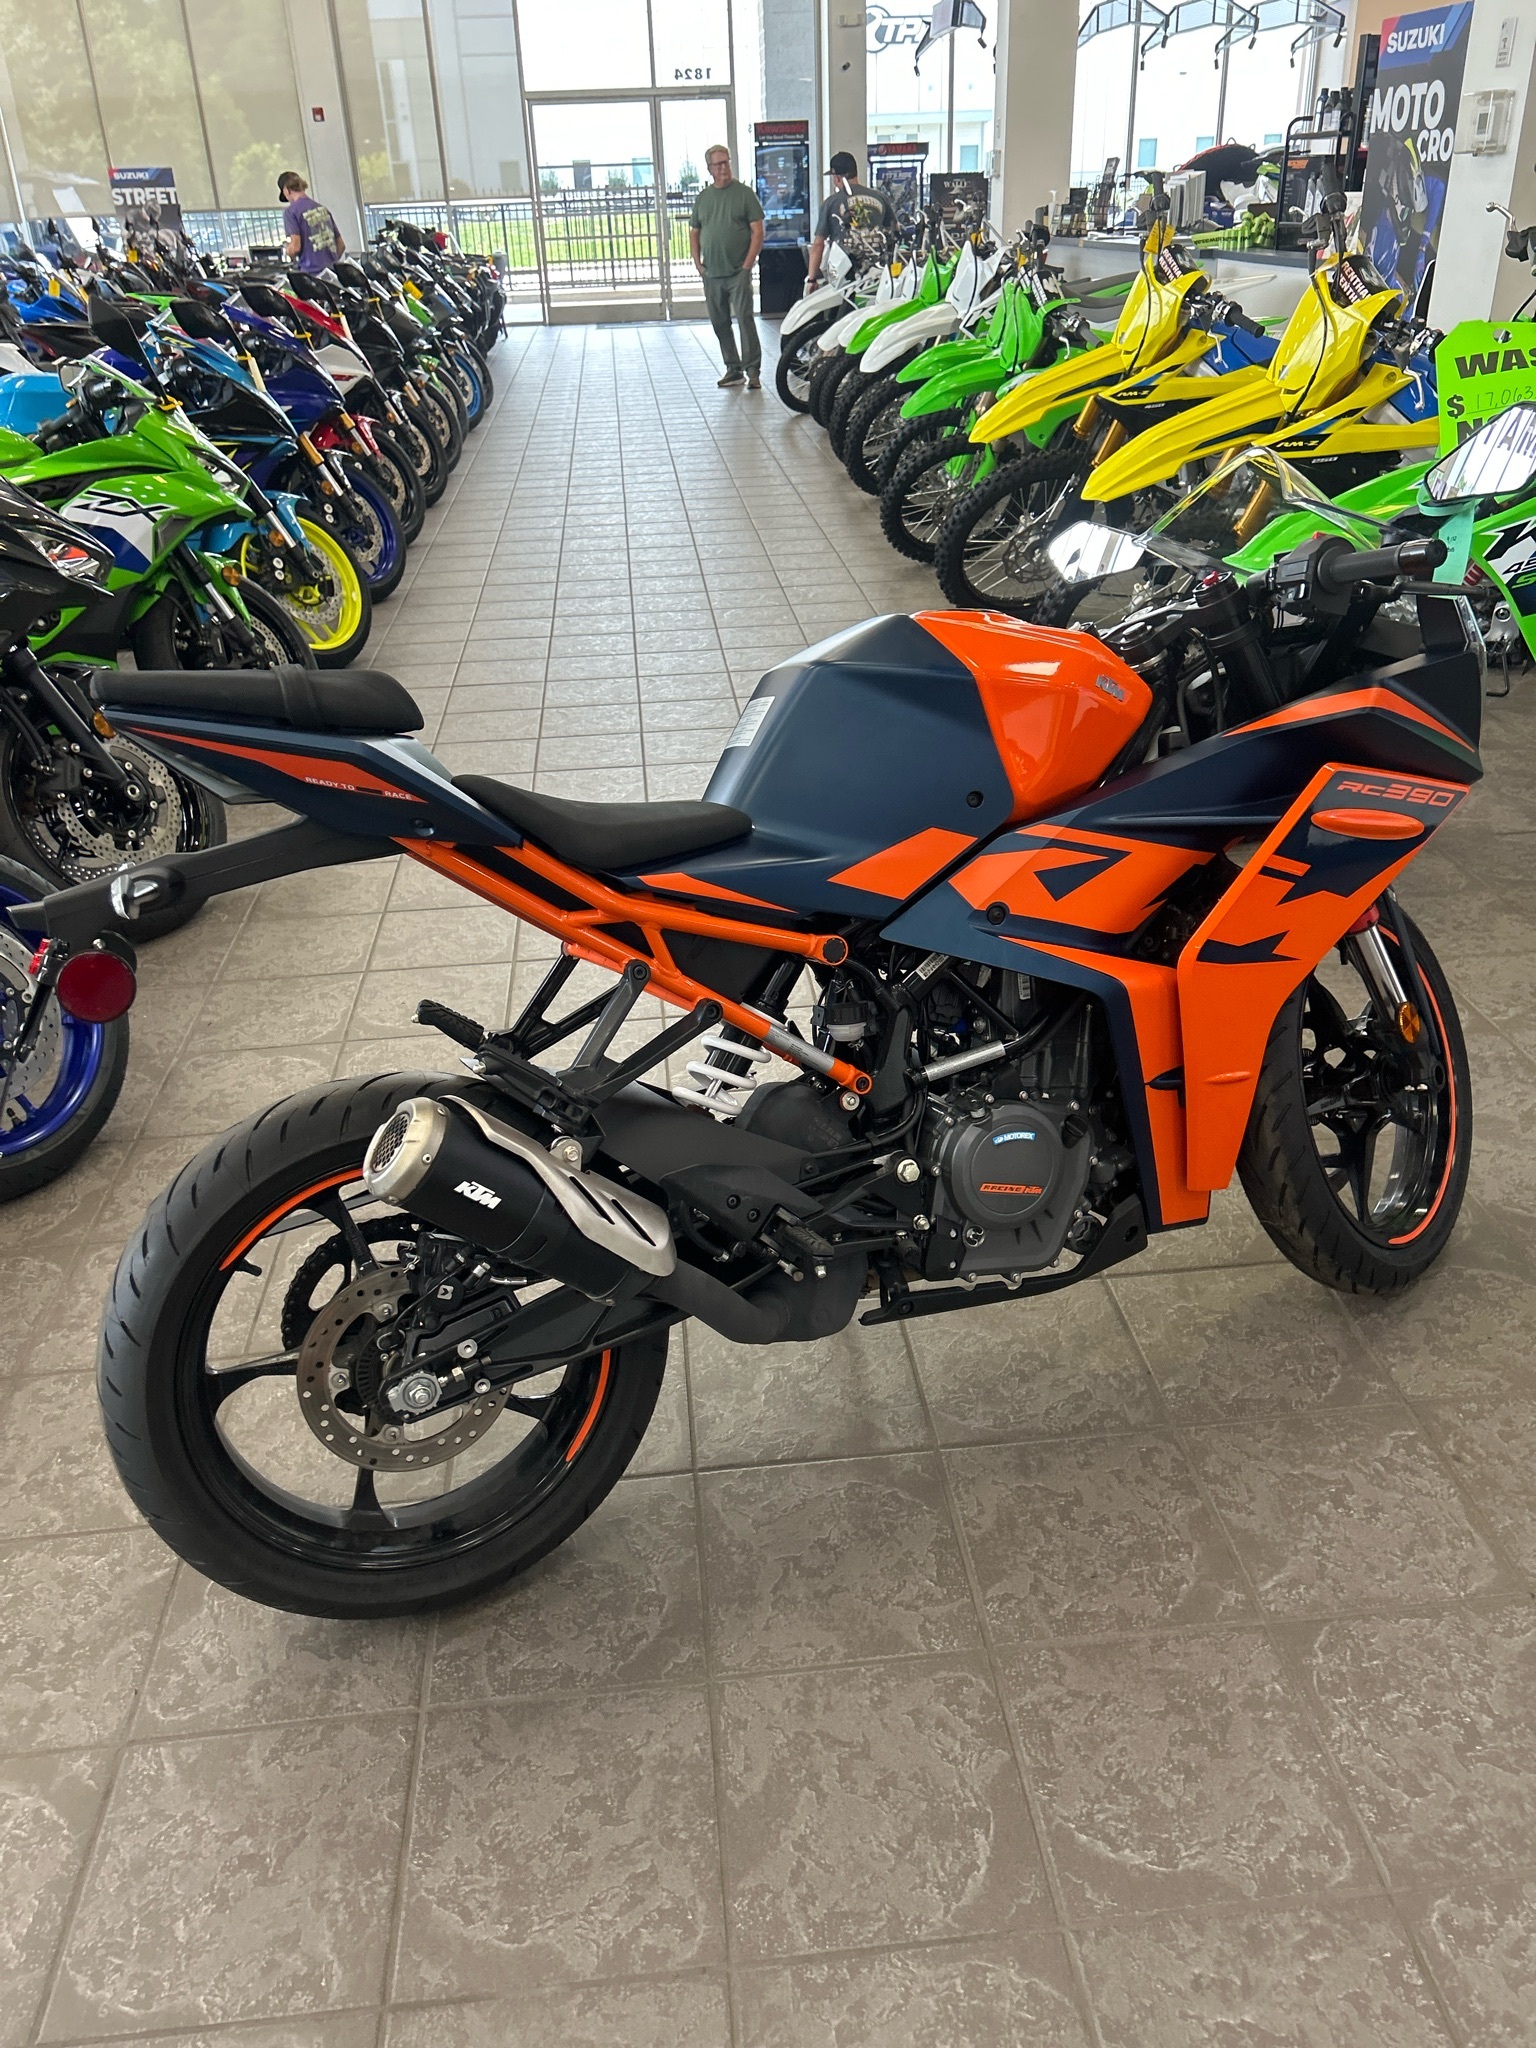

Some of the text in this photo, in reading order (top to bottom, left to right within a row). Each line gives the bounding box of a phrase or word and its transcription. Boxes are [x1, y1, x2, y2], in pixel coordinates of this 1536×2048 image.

[1387, 23, 1446, 54] SUZUKI
[1370, 79, 1445, 133] MOTO
[113, 171, 150, 180] SUZUKI
[1446, 394, 1465, 419] $
[1276, 440, 1319, 448] RM-Z
[1095, 674, 1125, 702] KTM
[305, 776, 412, 800] READY TO RACE
[1337, 781, 1455, 807] RC390
[1004, 1132, 1036, 1142] MOTOREX
[453, 1180, 502, 1210] KTM
